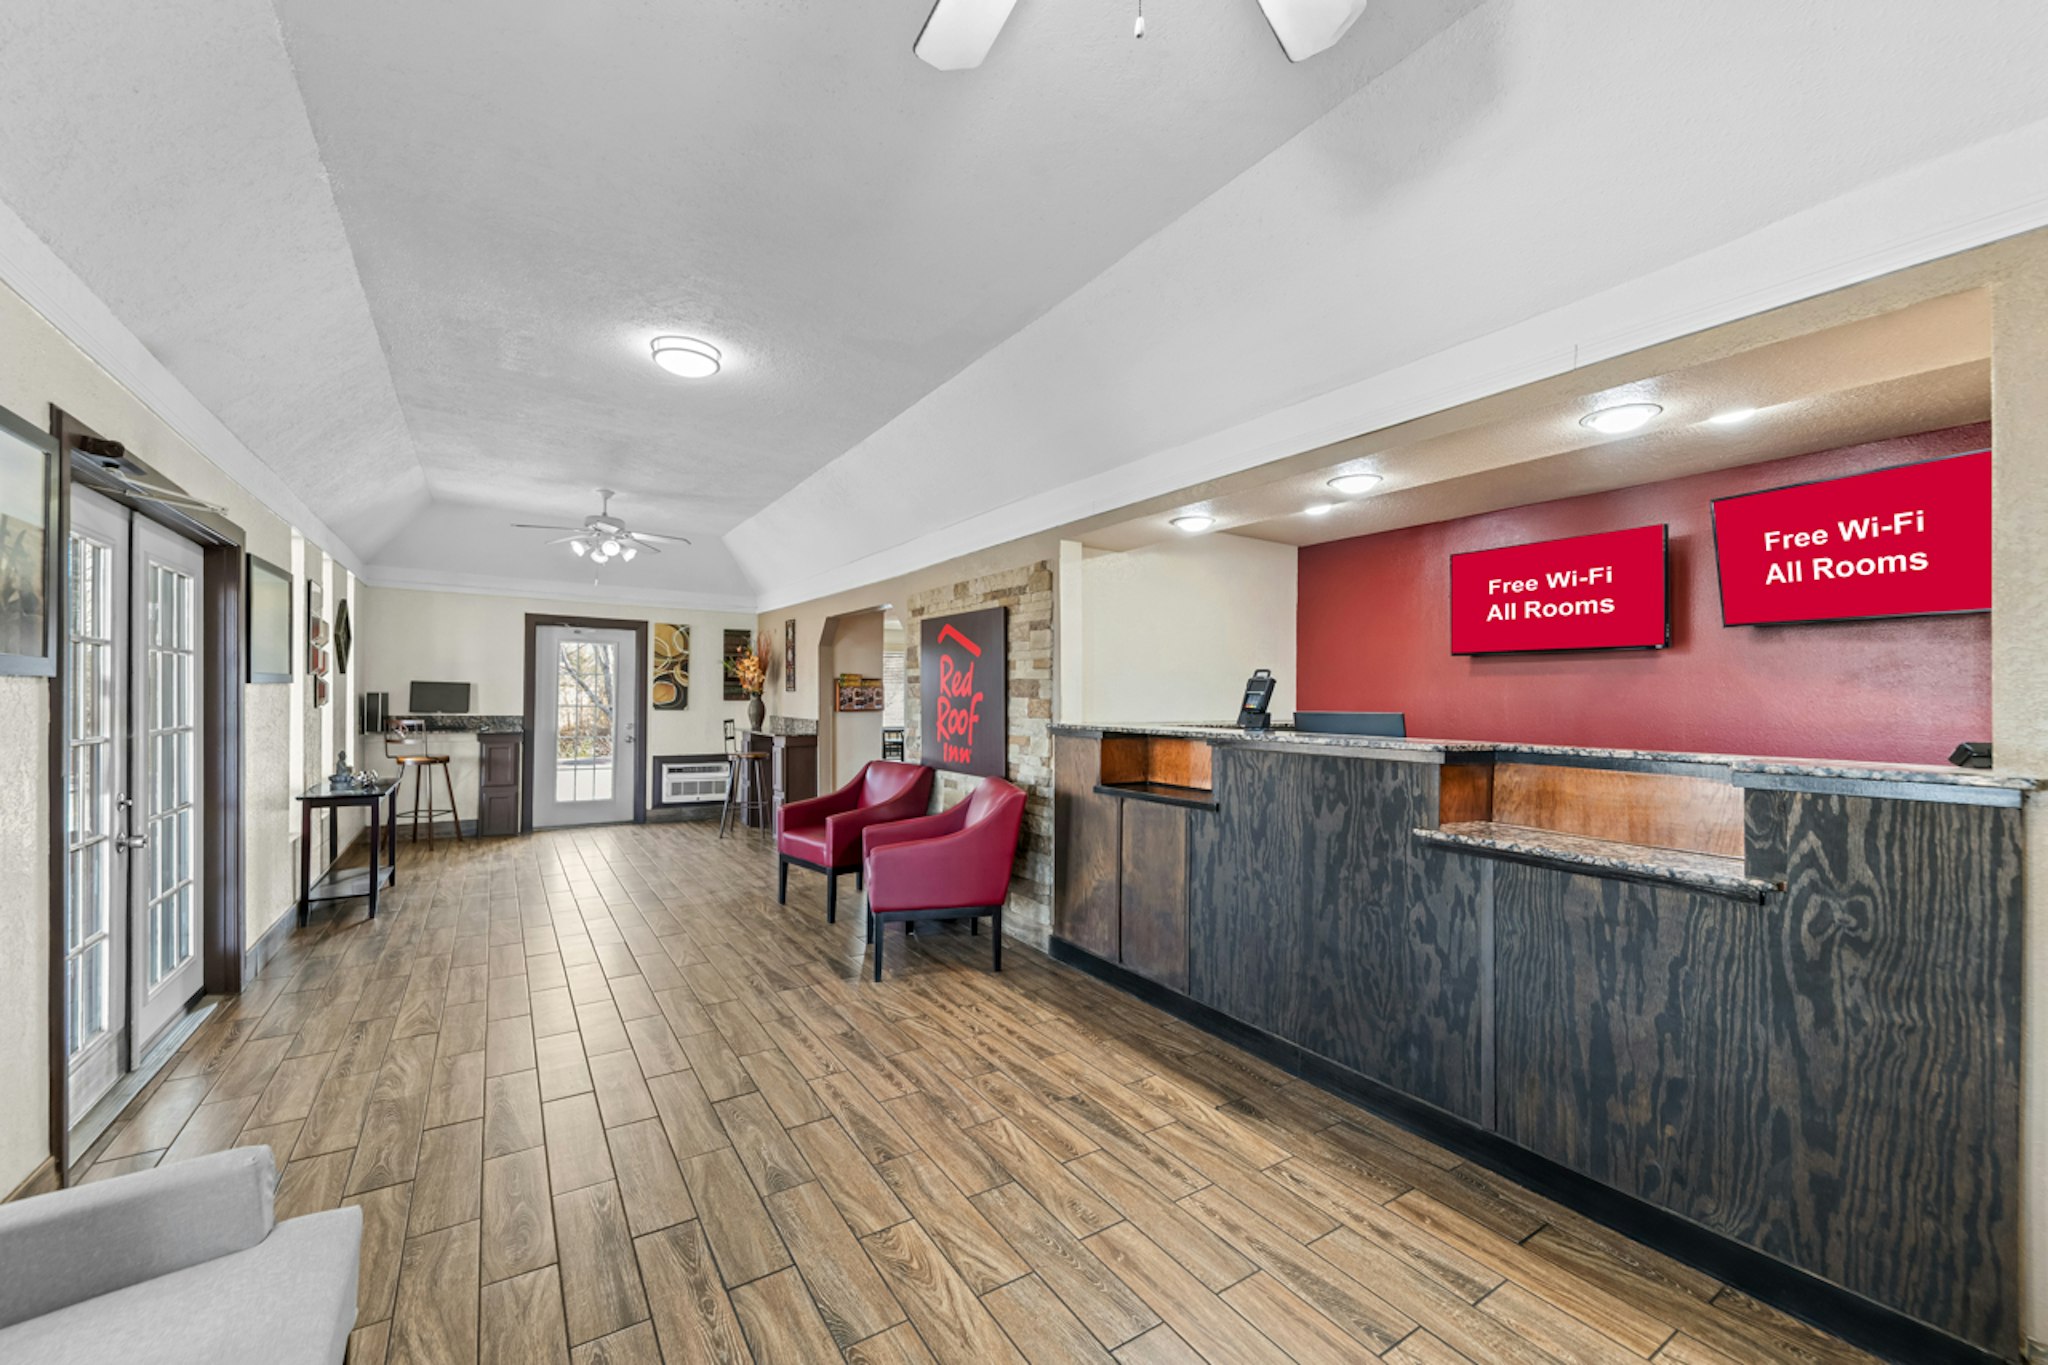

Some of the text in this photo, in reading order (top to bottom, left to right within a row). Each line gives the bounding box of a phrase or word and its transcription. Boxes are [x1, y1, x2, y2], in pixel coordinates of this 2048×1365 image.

[1764, 509, 1925, 552] Free Wi-Fi
[1488, 565, 1613, 595] Free Wi-Fi
[1765, 551, 1929, 586] All Rooms
[1486, 597, 1616, 622] All Rooms
[939, 653, 975, 698] Red
[936, 691, 985, 746] Roof
